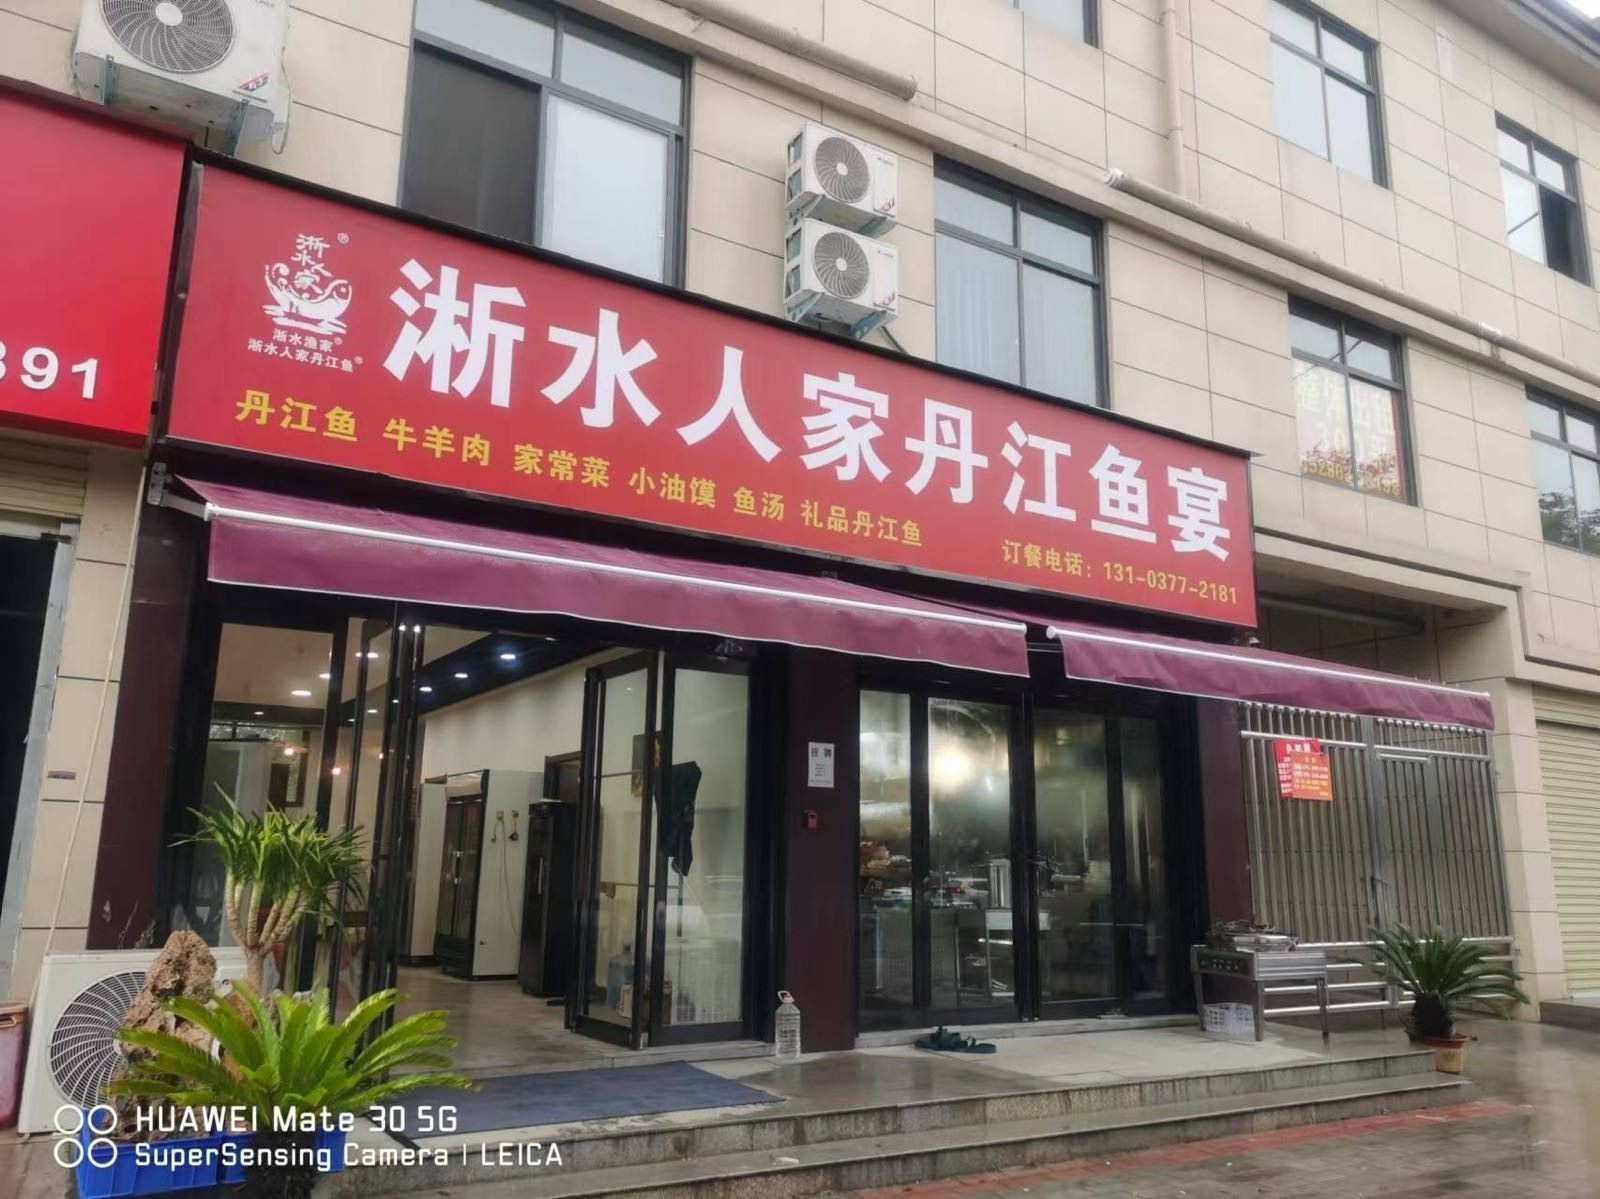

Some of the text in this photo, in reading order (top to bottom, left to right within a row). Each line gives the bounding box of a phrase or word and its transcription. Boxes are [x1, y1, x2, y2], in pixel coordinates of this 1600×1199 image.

[0, 340, 98, 399] 91
[383, 258, 1231, 562] 淅水人家丹江鱼宴
[236, 389, 922, 547] 丹江鱼 牛羊肉 家常菜 小油馍 鱼汤 礼品丹江鱼
[1103, 561, 1237, 605] 131-0377-2181
